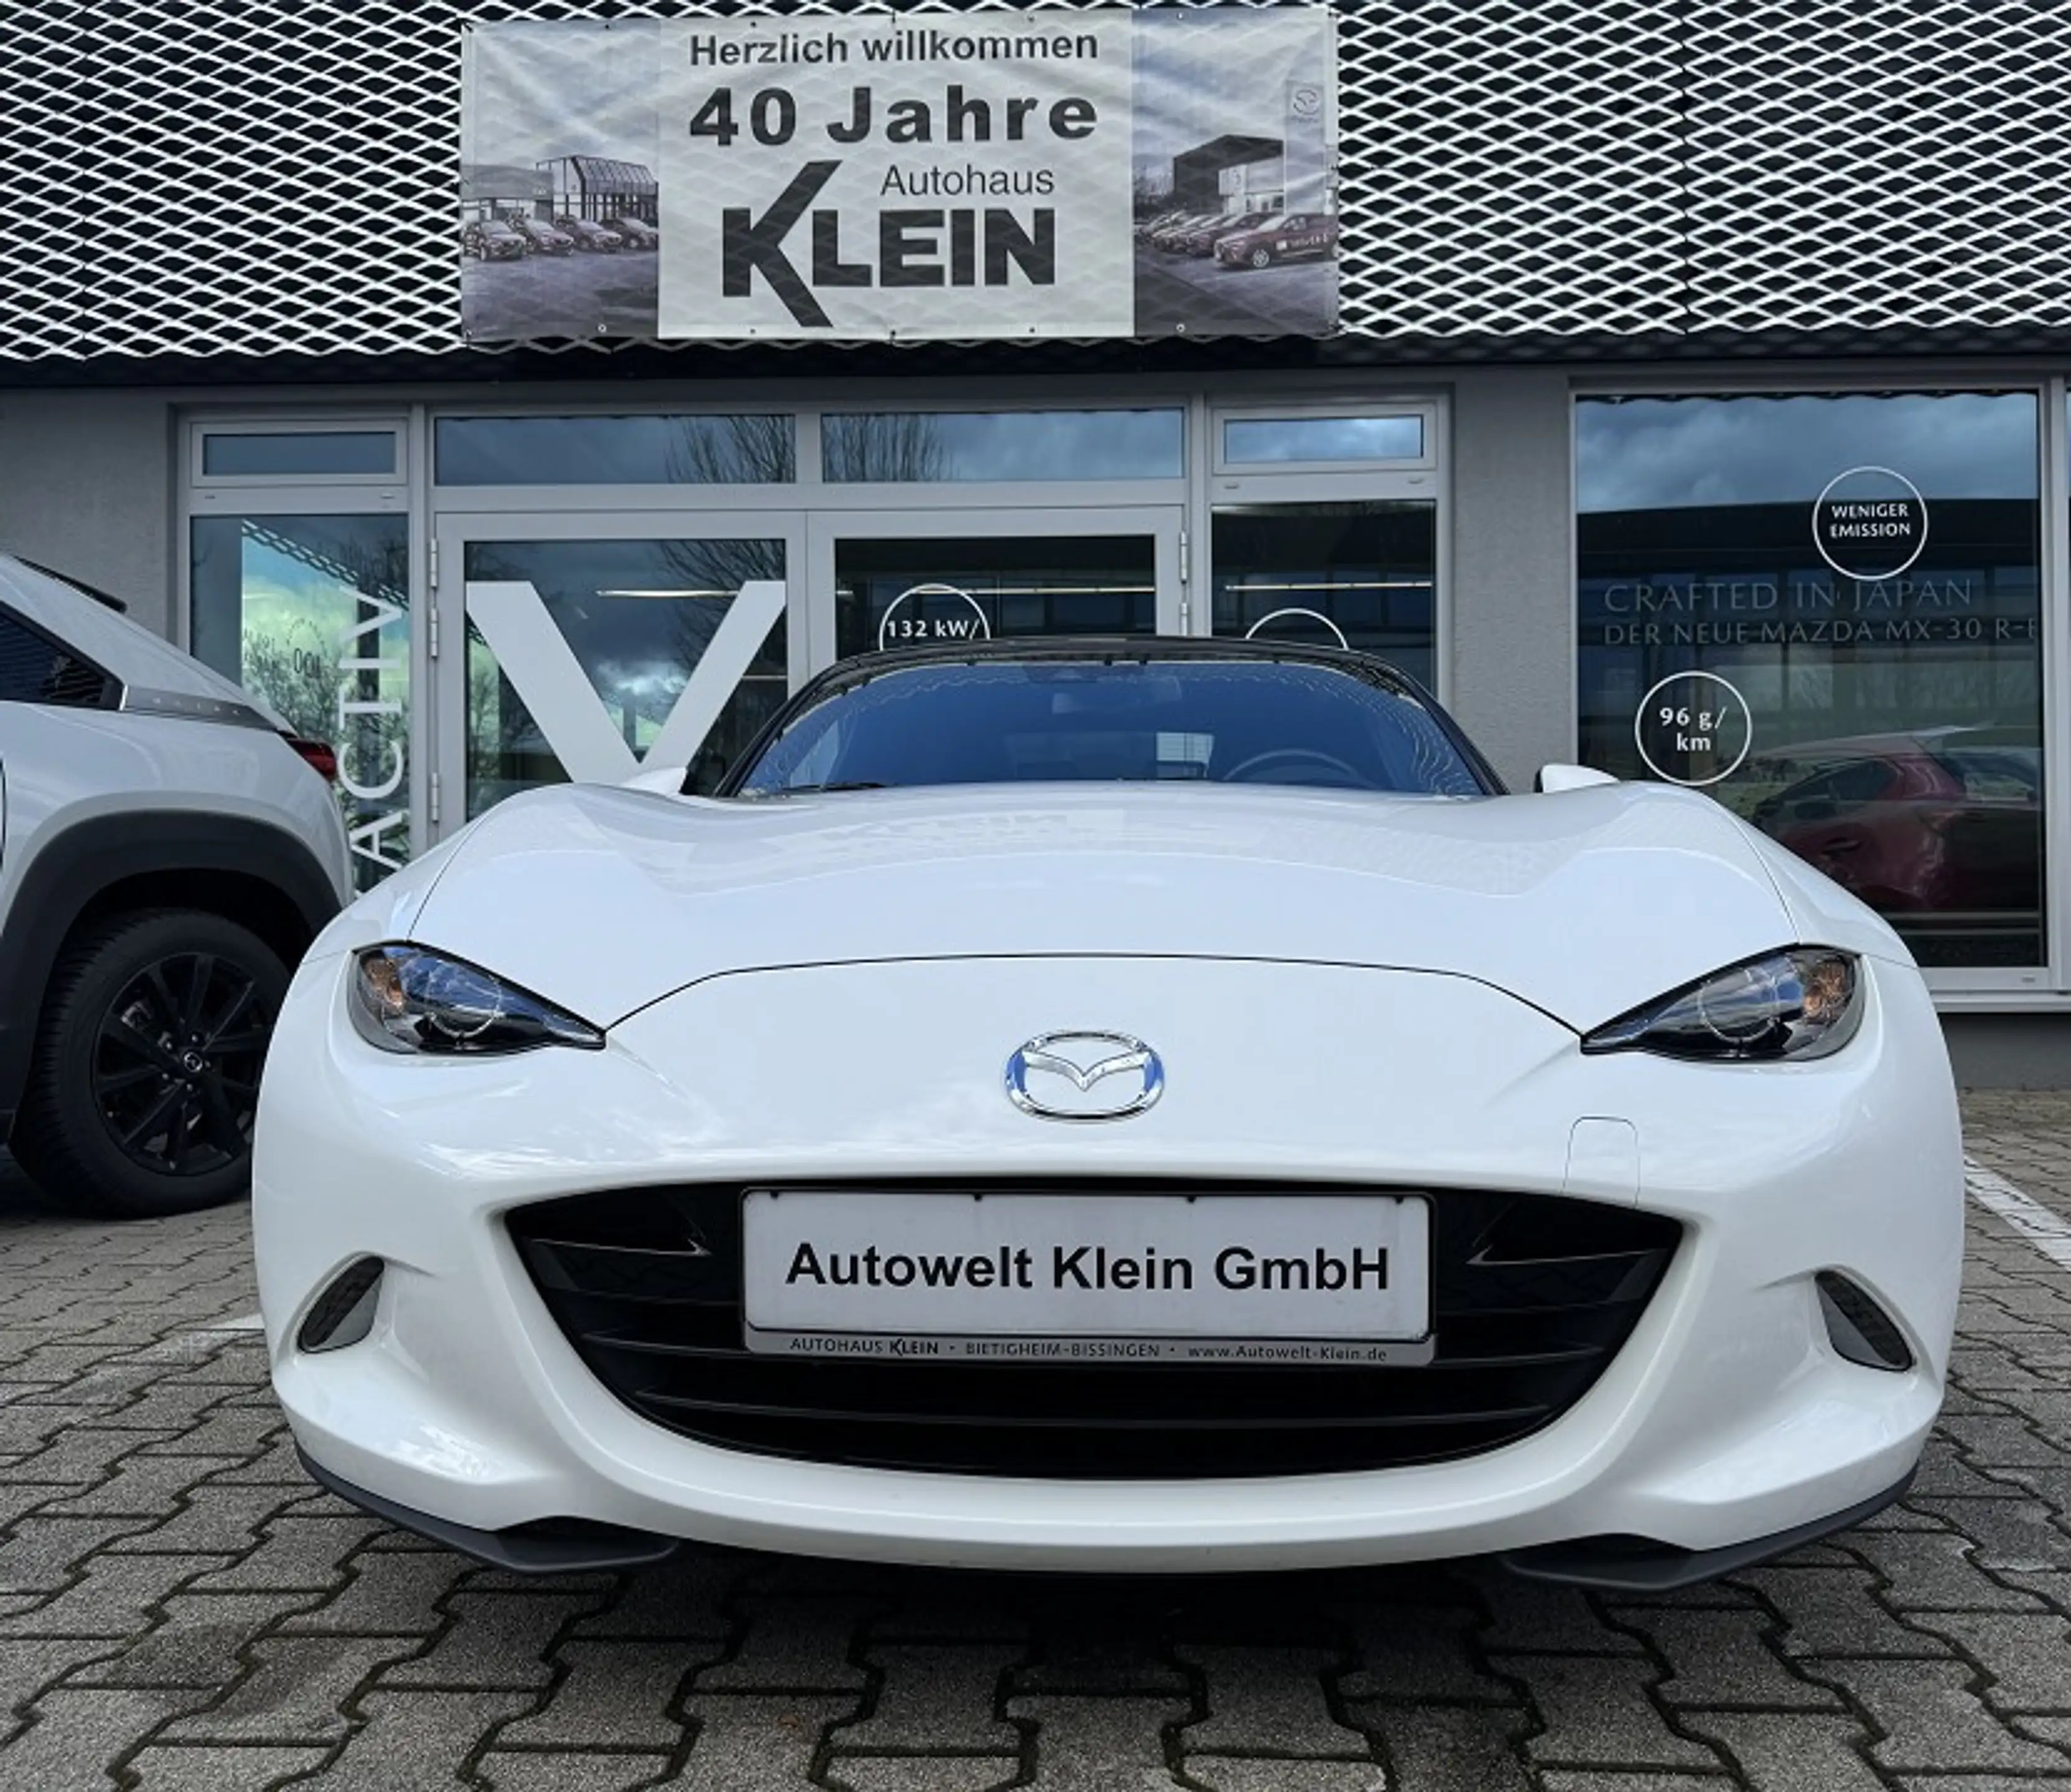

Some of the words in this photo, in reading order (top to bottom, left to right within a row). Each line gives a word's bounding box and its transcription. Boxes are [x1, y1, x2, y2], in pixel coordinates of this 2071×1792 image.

[691, 34, 847, 65] Herzlich
[863, 30, 1097, 61] willkommen
[690, 87, 796, 146] 40
[826, 85, 1096, 143] Jahre
[880, 164, 1055, 195] Autohaus
[722, 159, 1055, 328] KLEIN
[1831, 503, 1909, 519] WENIGER
[1830, 523, 1910, 539] EMISSION
[1604, 582, 1778, 612] CRAFTED
[1797, 581, 1835, 609] IN
[1853, 579, 1971, 612] JAPAN
[887, 620, 928, 638] 132
[935, 618, 980, 640] kW/
[1604, 623, 1662, 645] DER
[1674, 622, 1748, 644] NEUE
[1761, 620, 1873, 642] MAZDA
[1886, 617, 1983, 640] MX-30
[1659, 707, 1690, 727] 96
[1699, 705, 1727, 731] g/
[339, 585, 403, 897] ACTIV
[1676, 732, 1711, 751] km
[785, 1243, 1033, 1287] Autowelt
[1054, 1246, 1193, 1289] Klein
[1215, 1246, 1387, 1290] GmbH
[790, 1338, 884, 1354] AUTOHAUS
[890, 1338, 938, 1356] KLEIN
[966, 1342, 1159, 1358] BIETIGHEIM-BISSINGEN
[1188, 1345, 1387, 1362] www.Autowelt-Klein.de
